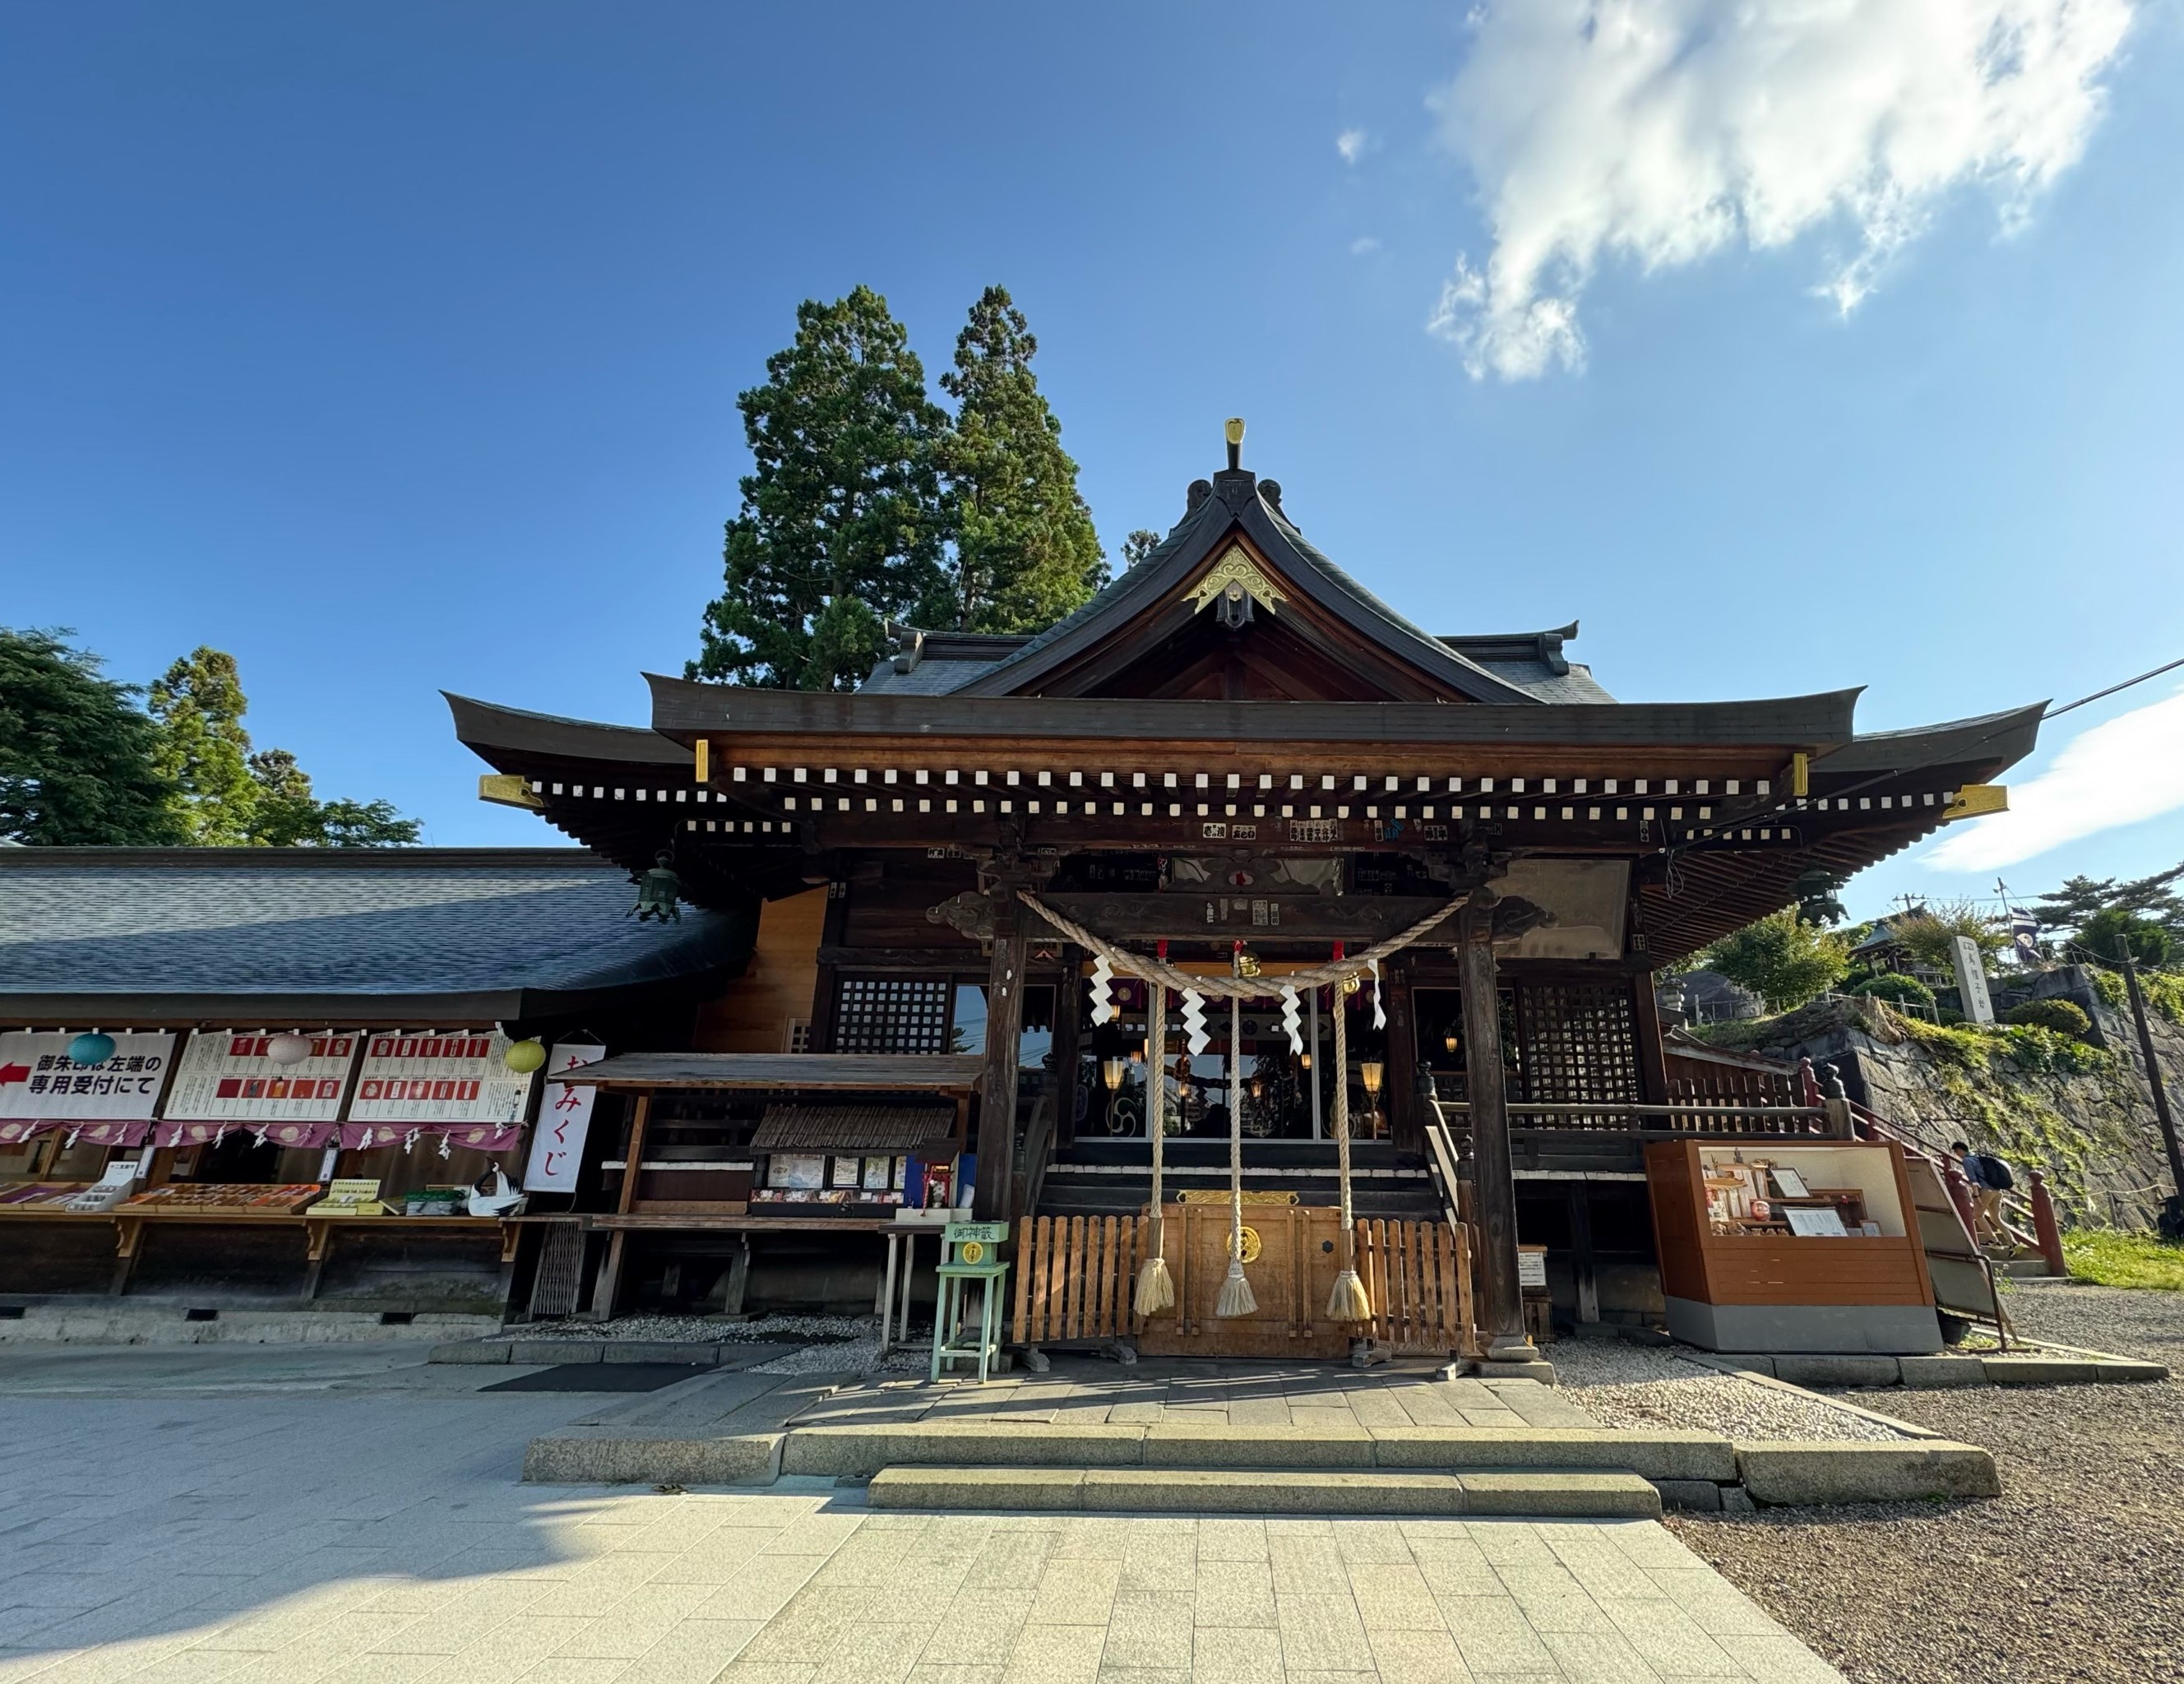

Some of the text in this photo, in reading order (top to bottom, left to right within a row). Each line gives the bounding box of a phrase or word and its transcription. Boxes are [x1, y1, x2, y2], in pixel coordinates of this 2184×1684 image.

[29, 1074, 155, 1095] 専用受付にて
